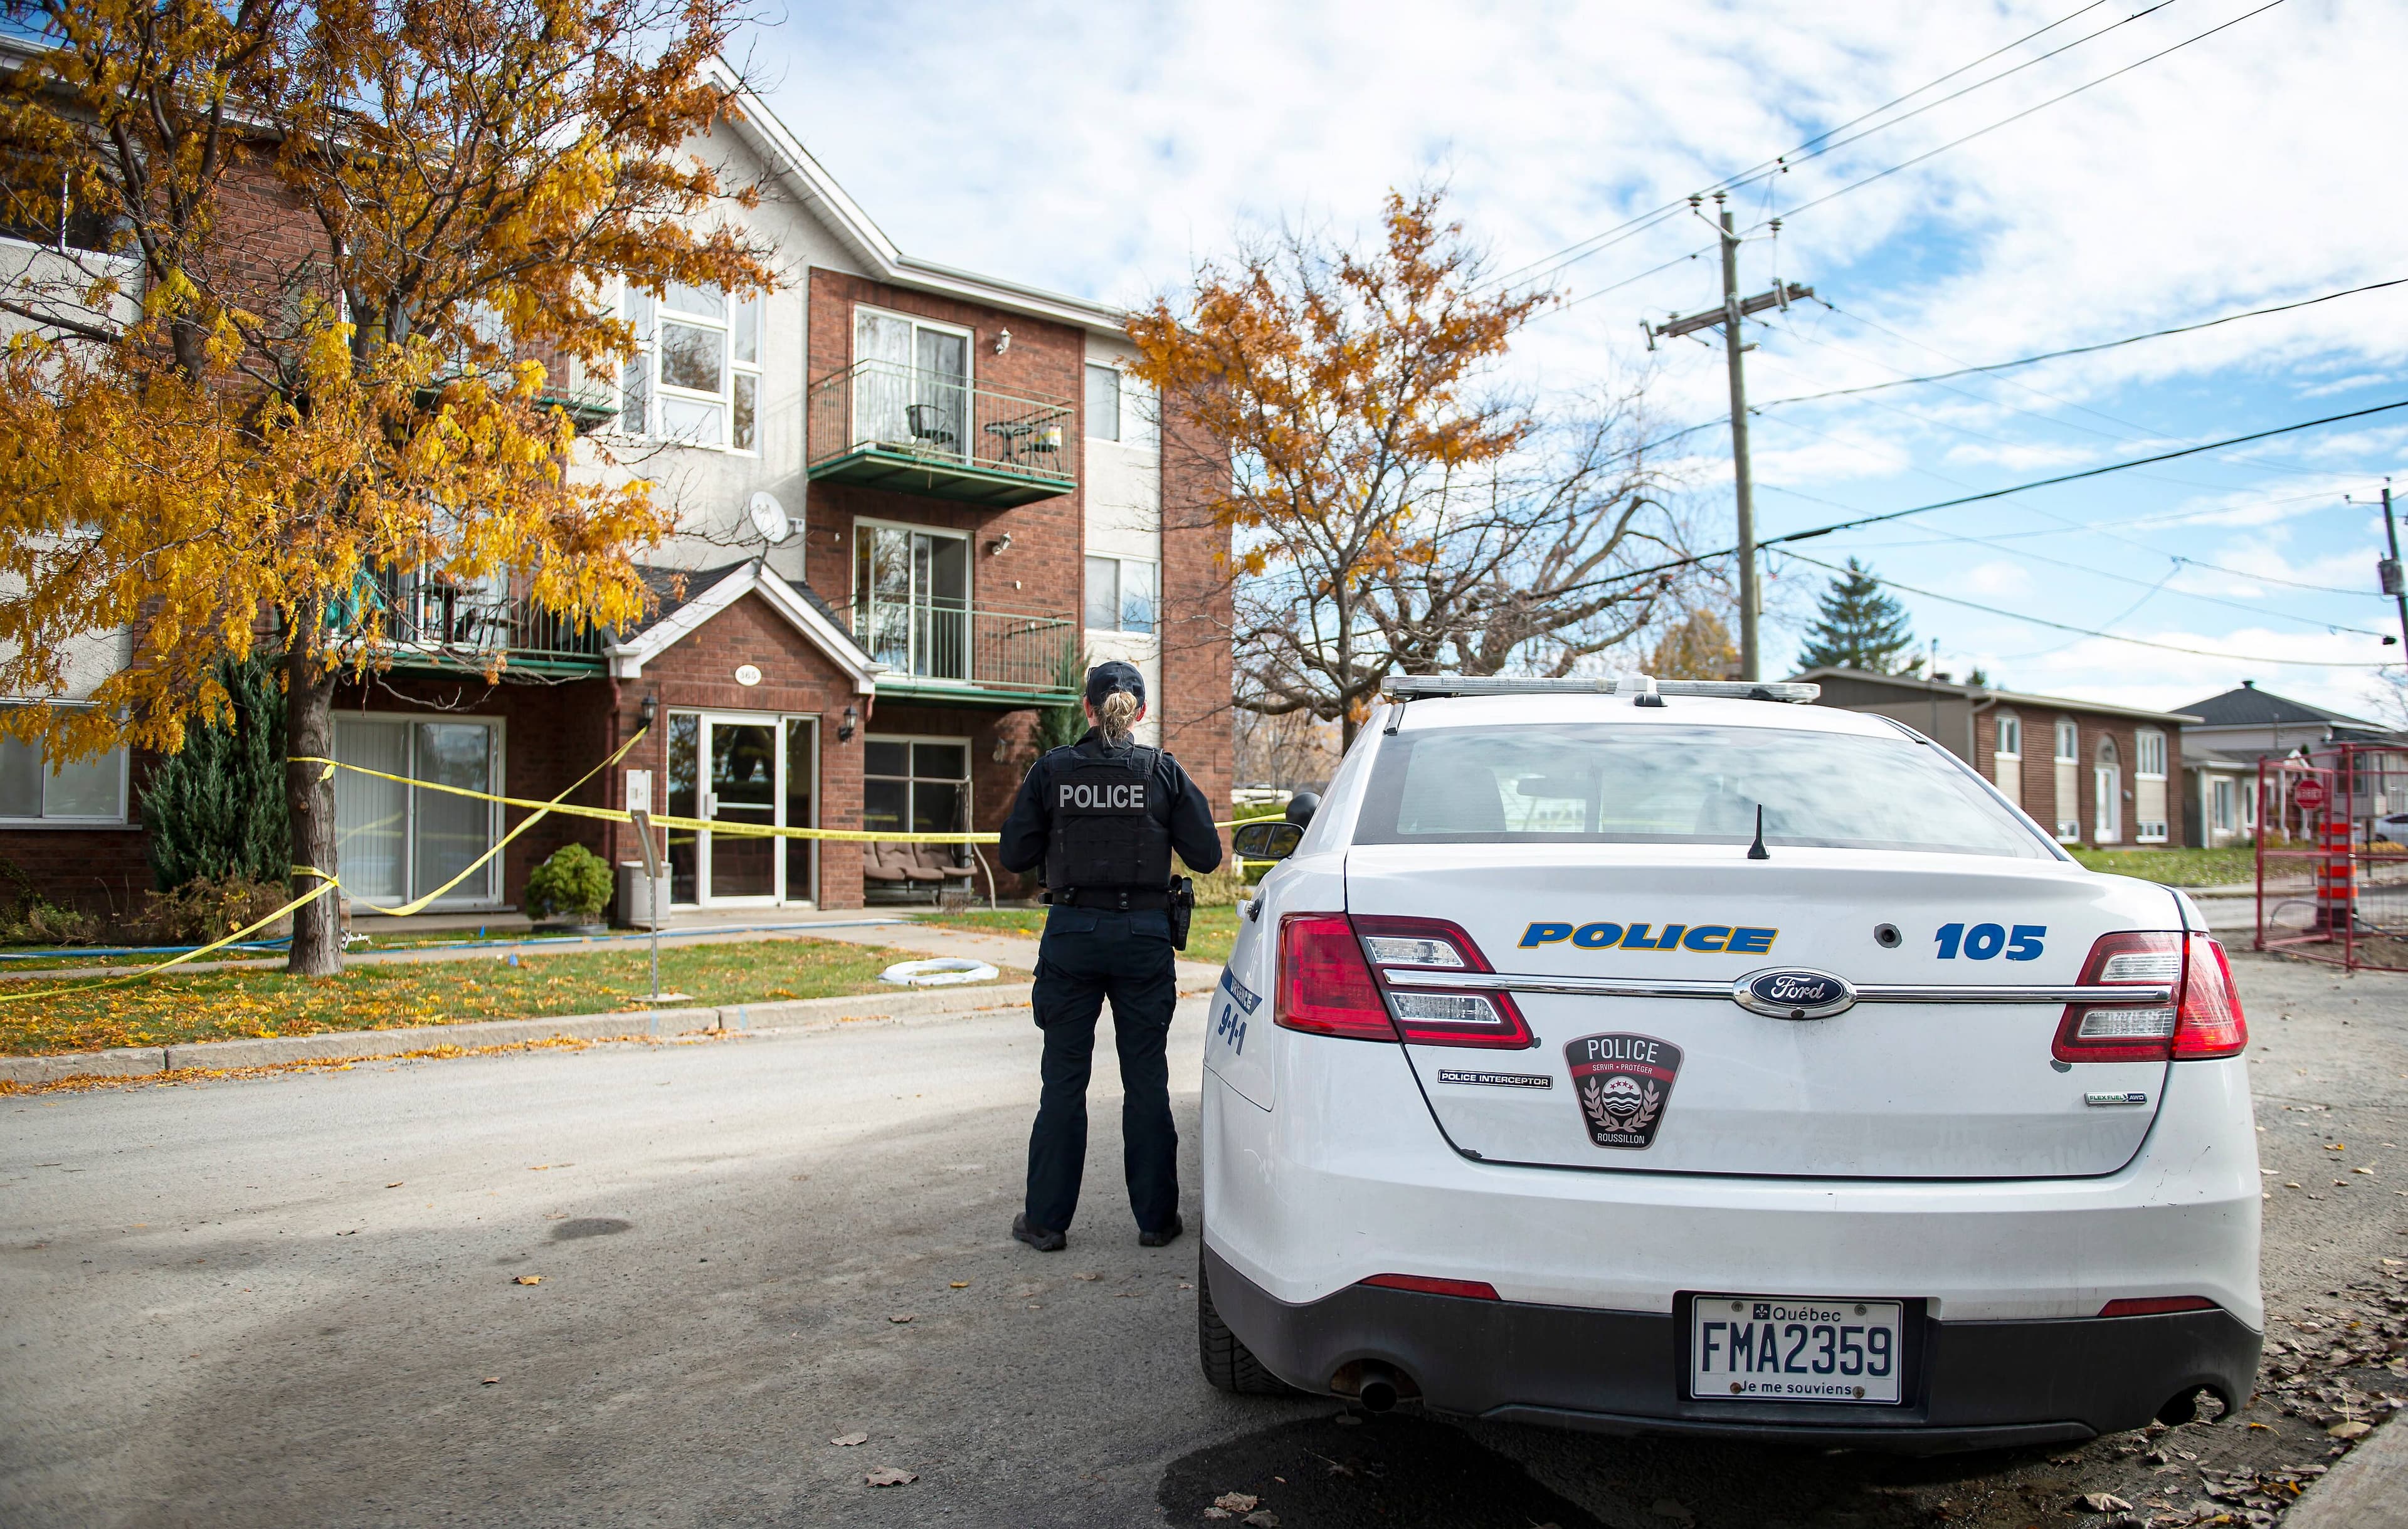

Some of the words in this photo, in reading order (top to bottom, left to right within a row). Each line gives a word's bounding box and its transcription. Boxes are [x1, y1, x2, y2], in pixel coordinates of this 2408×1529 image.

[1060, 785, 1144, 807] POLICE
[1518, 922, 1779, 955] POLICE
[1935, 923, 2047, 961] 105
[1230, 977, 1253, 1011] URGENCE
[1771, 975, 1825, 999] Ford
[1218, 1003, 1247, 1056] 9-1-1
[1587, 1038, 1659, 1063] POLICE
[1442, 1073, 1477, 1081] POLICE
[1479, 1075, 1549, 1086] INTERCEPTOR
[1620, 1064, 1653, 1074] PROTÉGER
[1597, 1133, 1645, 1143] ROUSSILLON
[1773, 1307, 1841, 1322] Québec
[1702, 1321, 1891, 1376] FMA2359
[1741, 1380, 1756, 1392] Je
[1761, 1384, 1782, 1393] me
[1787, 1382, 1852, 1395] souviens
